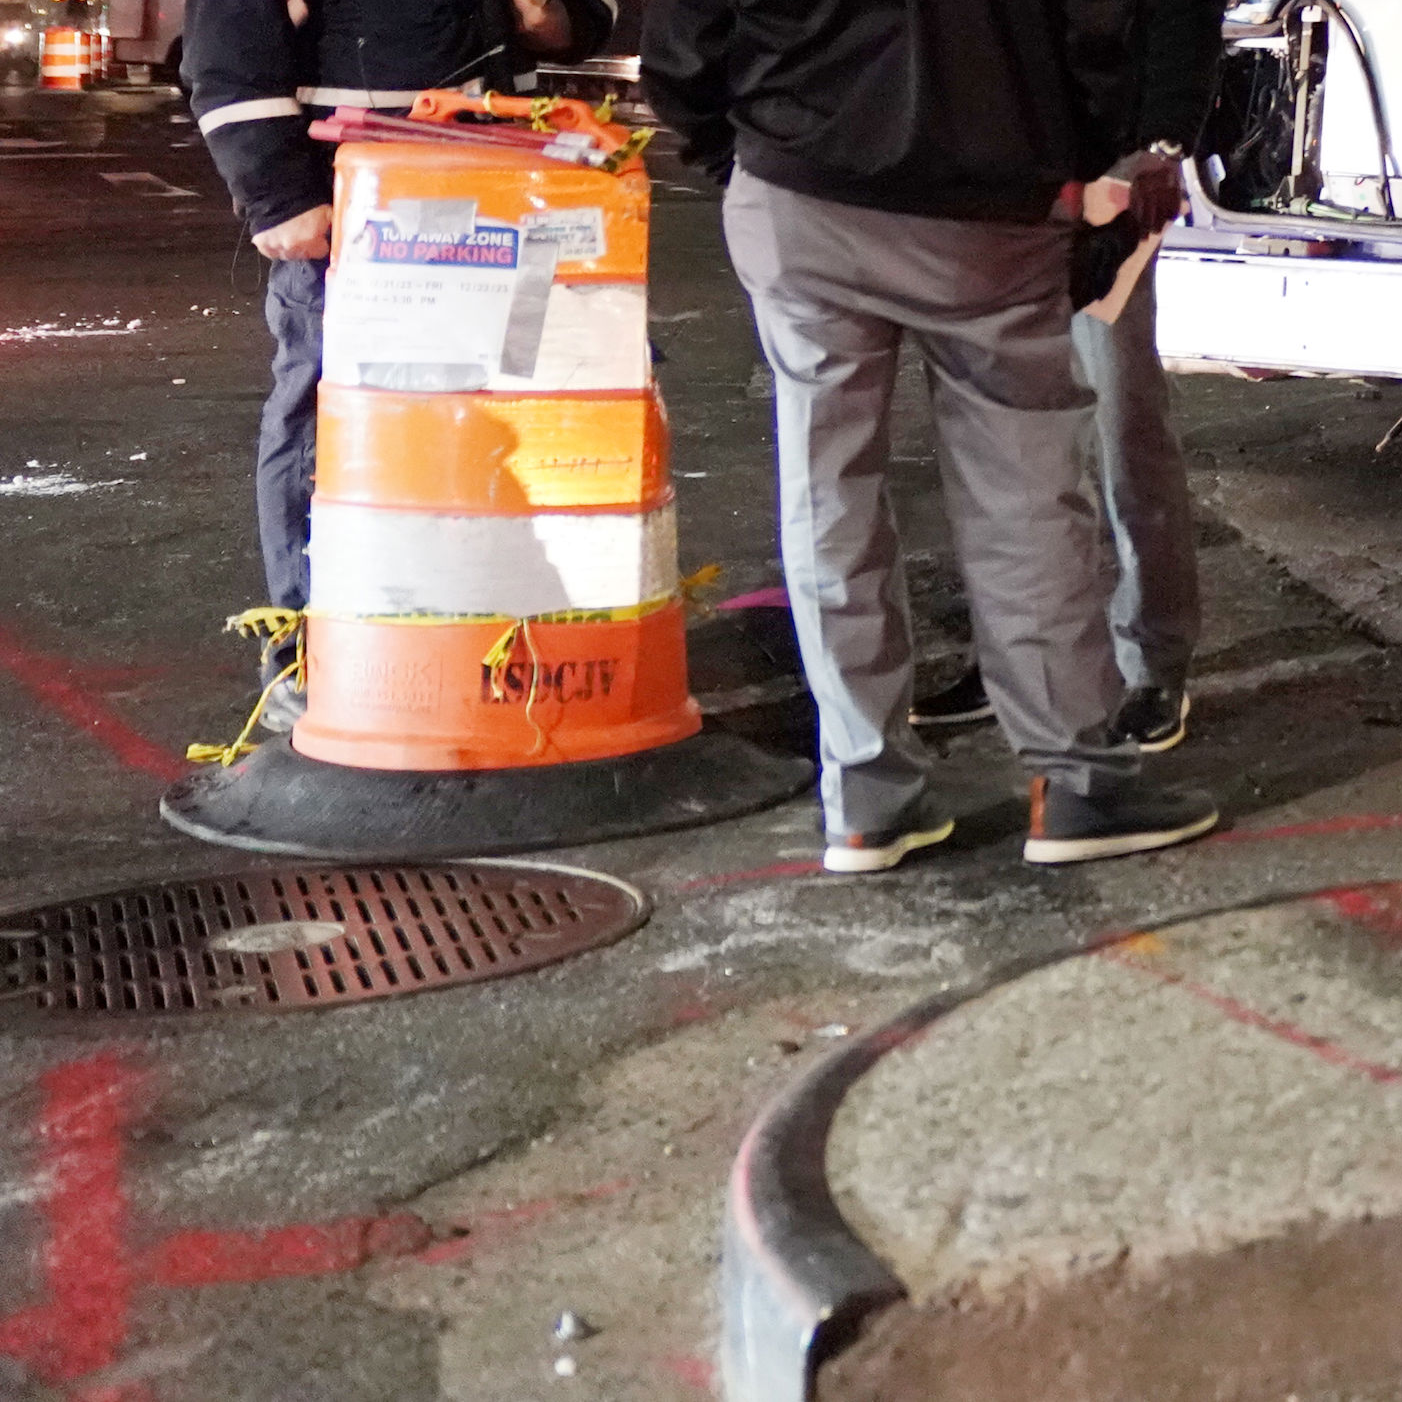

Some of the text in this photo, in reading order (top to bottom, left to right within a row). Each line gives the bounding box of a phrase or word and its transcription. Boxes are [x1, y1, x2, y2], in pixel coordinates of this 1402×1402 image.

[466, 230, 514, 247] ZONE
[378, 242, 514, 264] NO PARKING
